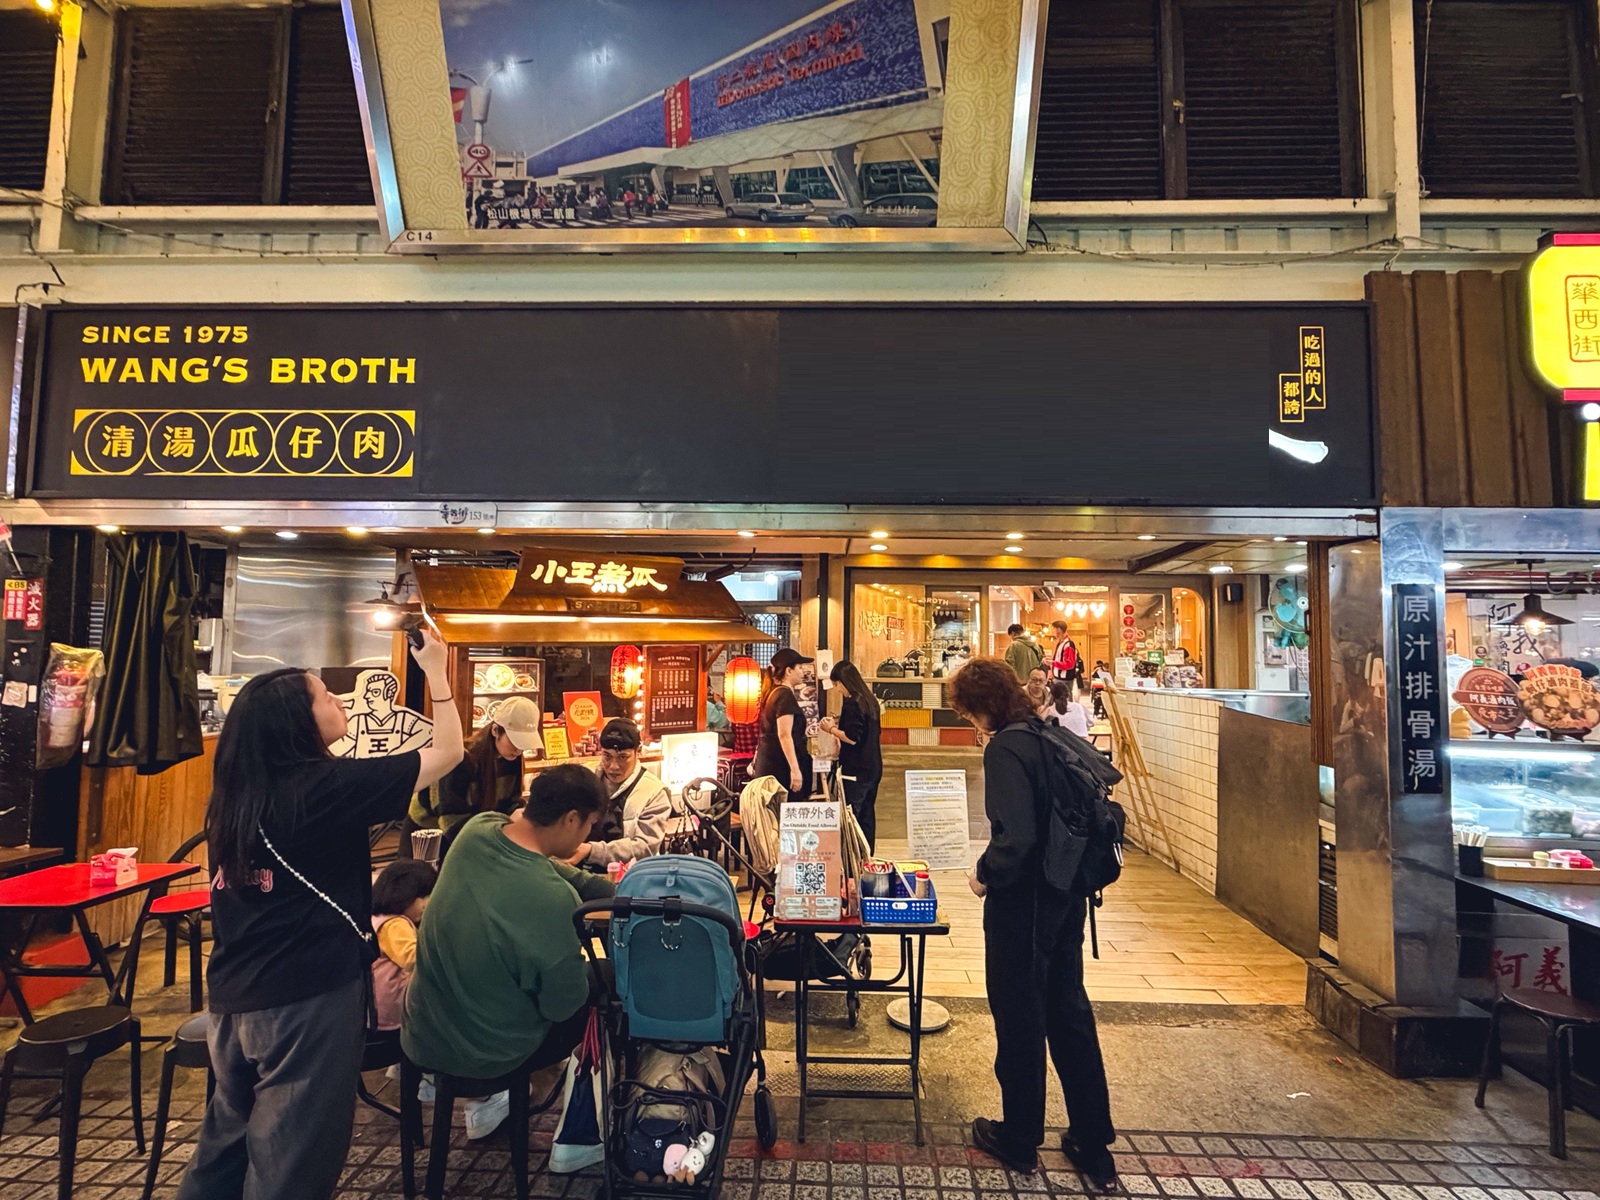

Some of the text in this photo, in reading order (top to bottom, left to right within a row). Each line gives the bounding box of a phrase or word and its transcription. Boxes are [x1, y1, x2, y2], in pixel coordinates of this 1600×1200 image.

[789, 43, 864, 81] Terminal
[406, 231, 432, 242] C14
[81, 325, 249, 344] SINCE 1975
[1571, 282, 1600, 356] 華西街
[80, 355, 417, 384] WANG'S BROTH
[1303, 334, 1323, 403] 吃過的人
[1283, 381, 1301, 415] 都誇
[101, 424, 386, 460] 清湯瓜仔肉
[469, 511, 482, 520] 153
[530, 559, 669, 594] 小王煮瓜
[27, 581, 42, 627] 滅火器
[1402, 594, 1437, 779] 原汁排骨湯
[368, 737, 389, 754] 王
[784, 806, 837, 820] 禁帶外食
[1488, 945, 1568, 996] 阿義
